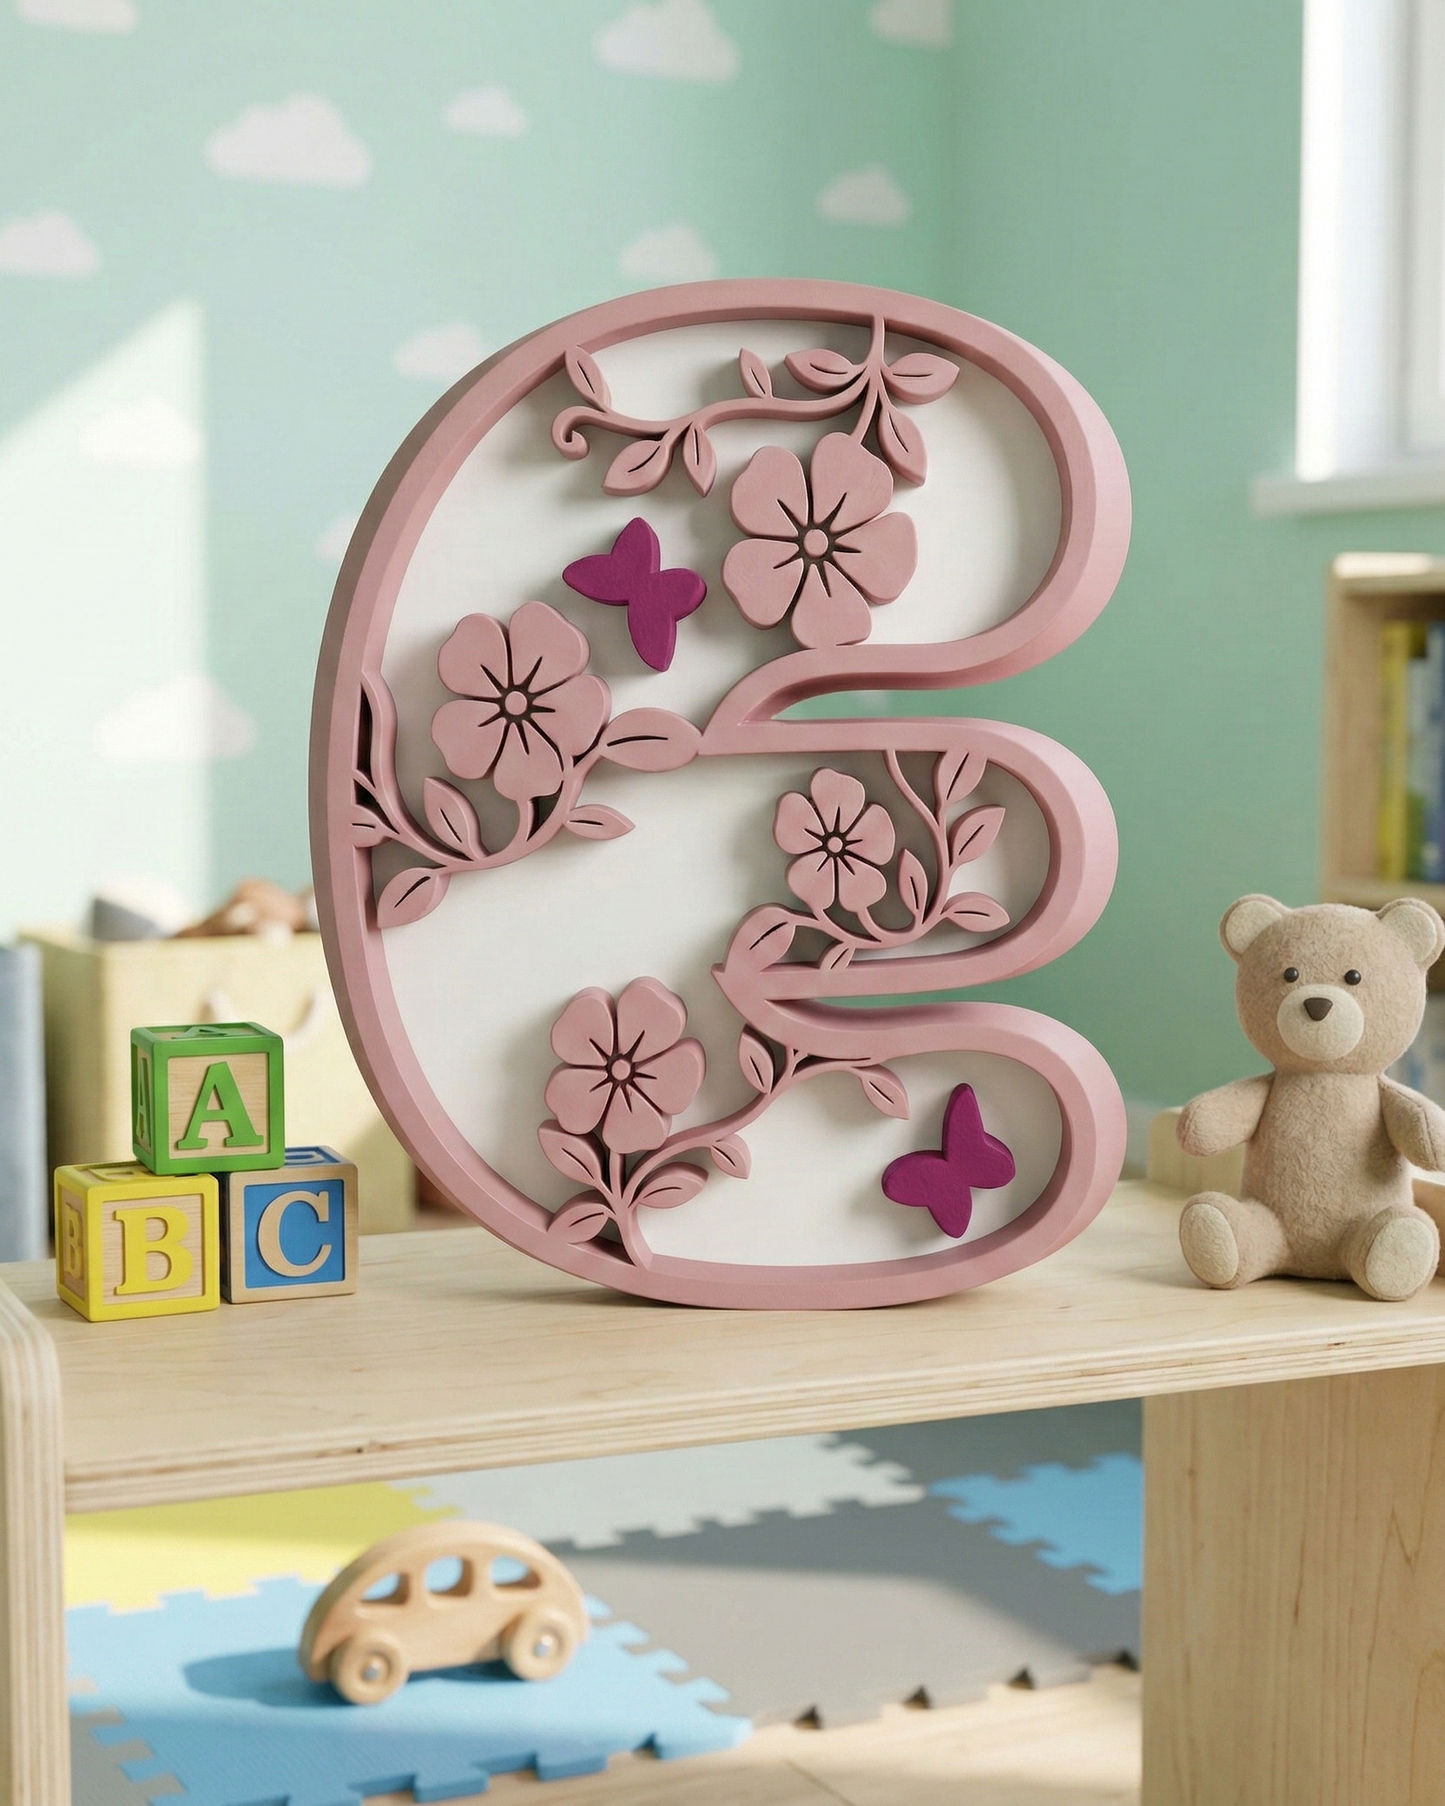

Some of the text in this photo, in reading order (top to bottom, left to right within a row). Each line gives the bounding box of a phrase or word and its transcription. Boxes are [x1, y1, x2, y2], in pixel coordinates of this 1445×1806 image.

[136, 1056, 151, 1149] A
[176, 1061, 264, 1150] A
[64, 1201, 83, 1280] B
[112, 1205, 194, 1296] B
[257, 1190, 333, 1278] C
